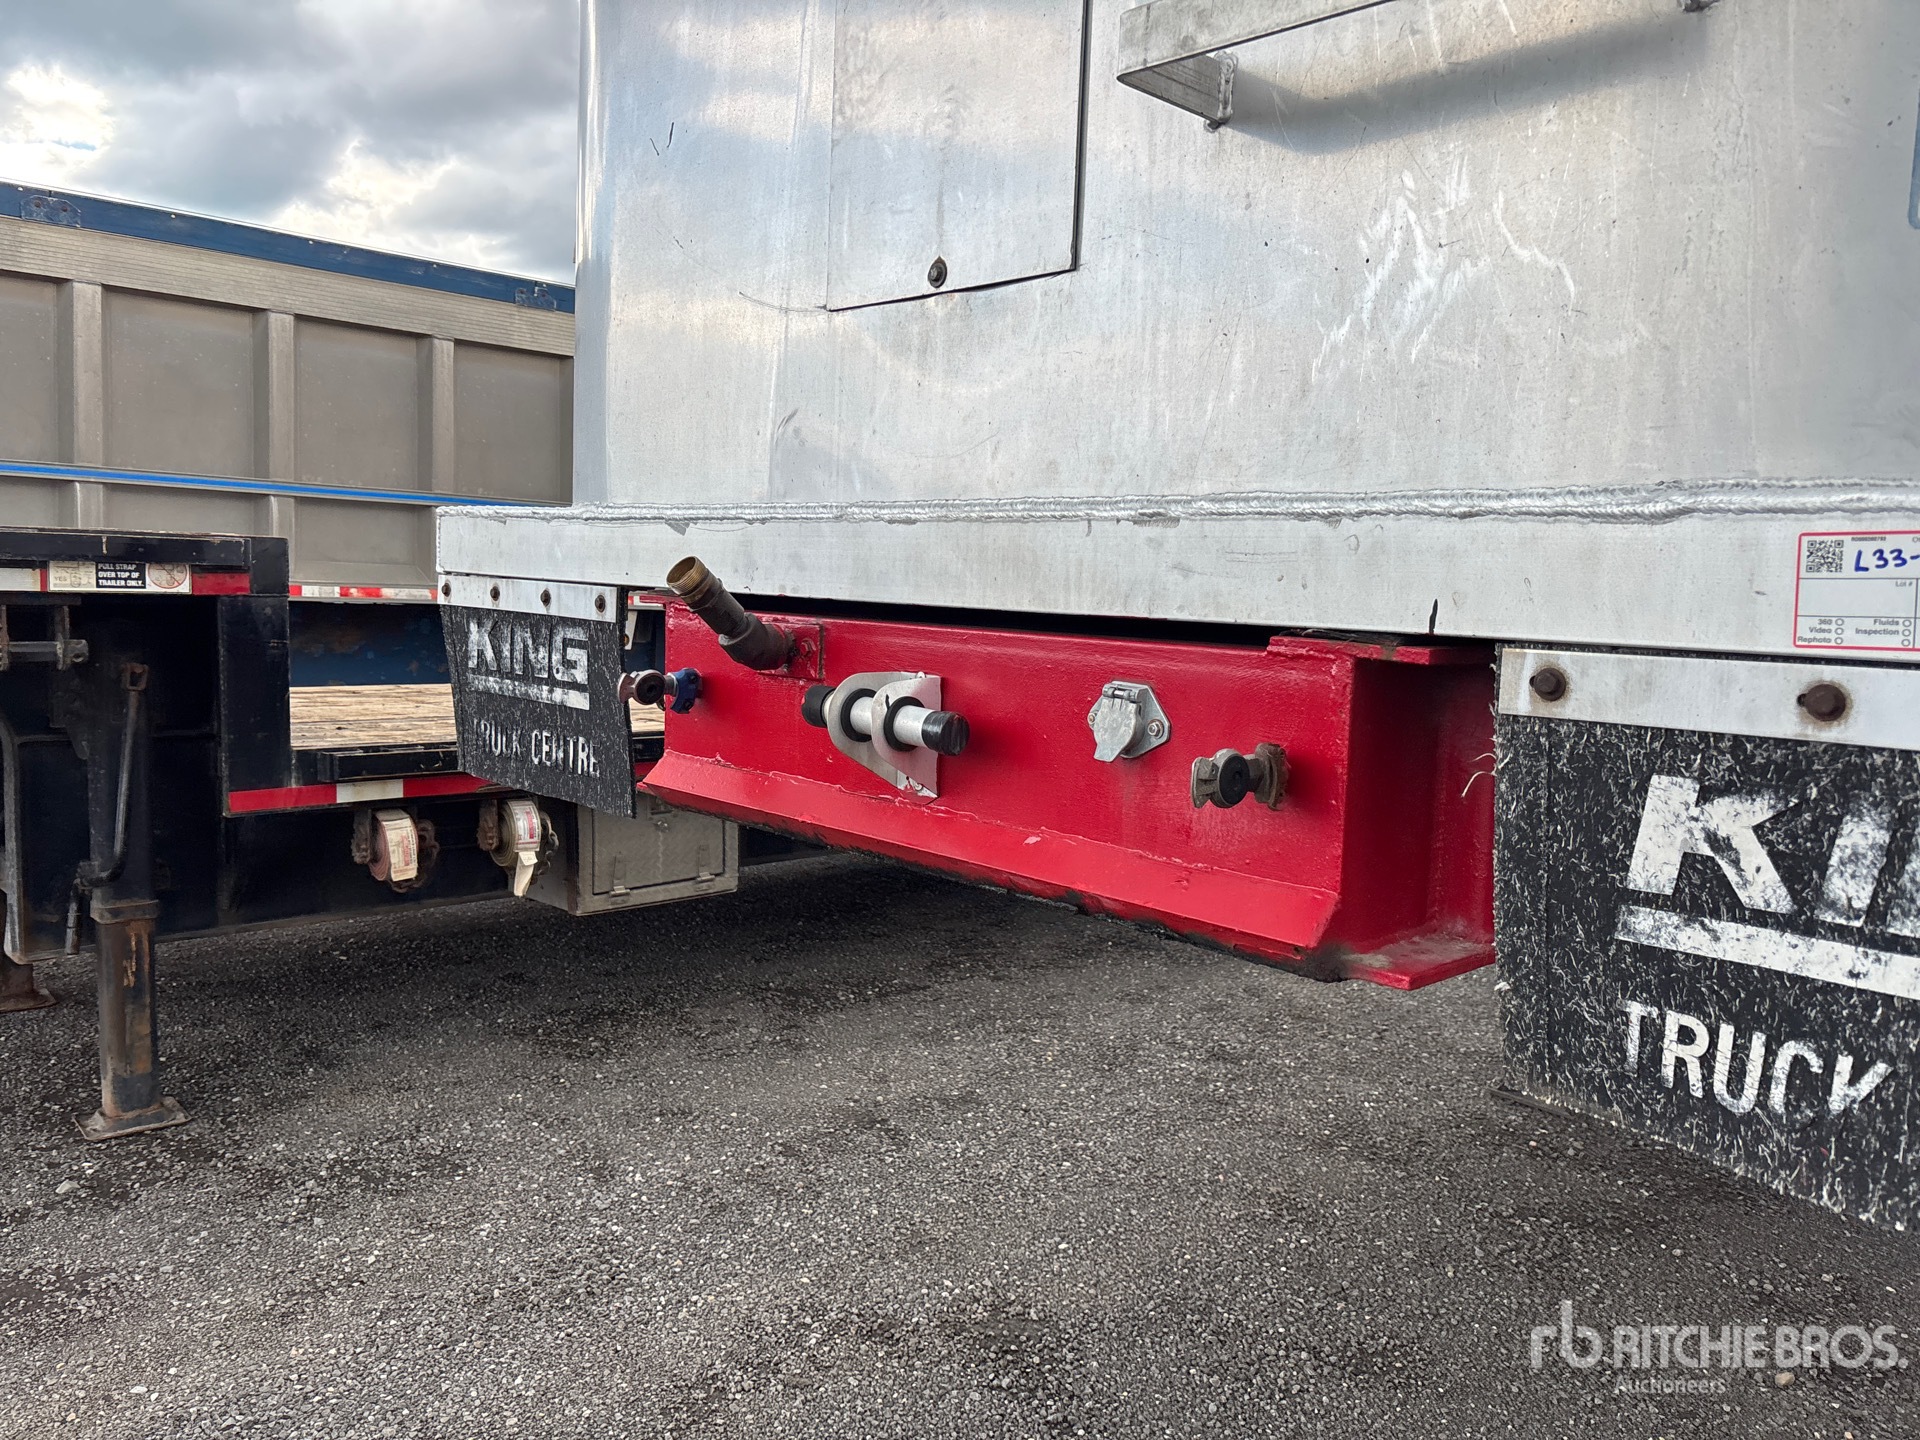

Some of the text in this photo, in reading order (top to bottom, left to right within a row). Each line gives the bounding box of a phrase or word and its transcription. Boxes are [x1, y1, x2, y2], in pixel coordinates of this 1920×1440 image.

[467, 619, 589, 685] KING
[1797, 636, 1832, 644] Rephoto
[1809, 626, 1832, 634] Video
[1855, 627, 1900, 636] Inspection
[474, 718, 601, 778] TRUCK CENTRE
[1626, 774, 1920, 938] KI
[1620, 999, 1894, 1119] TRUCK
